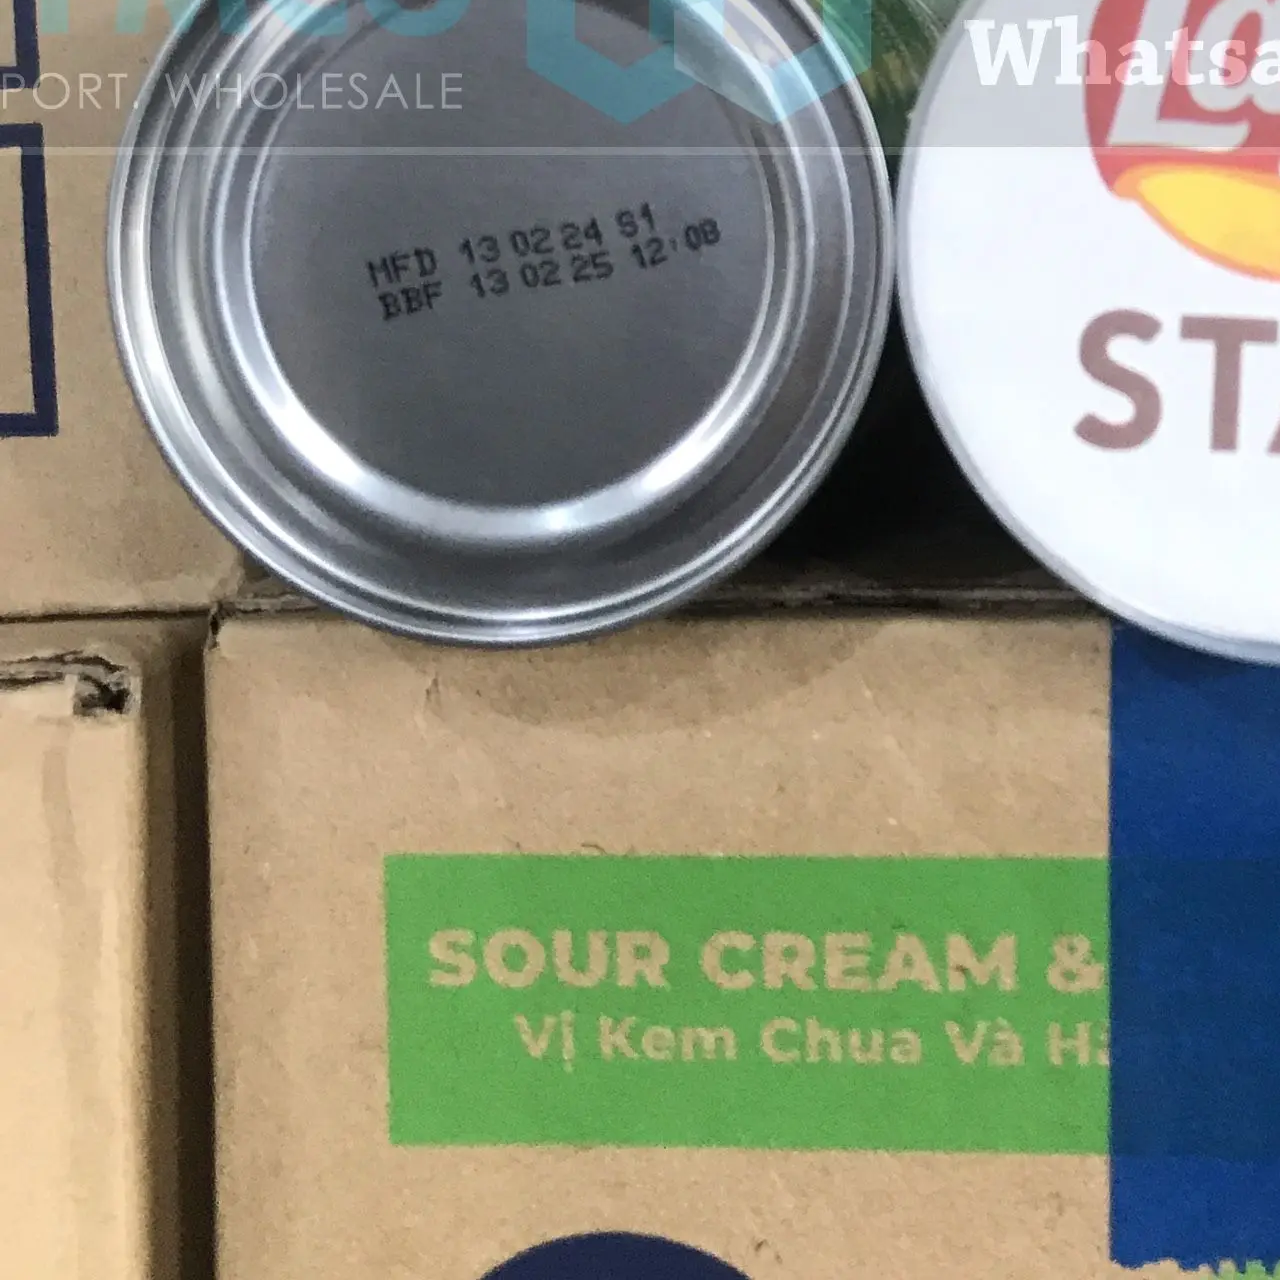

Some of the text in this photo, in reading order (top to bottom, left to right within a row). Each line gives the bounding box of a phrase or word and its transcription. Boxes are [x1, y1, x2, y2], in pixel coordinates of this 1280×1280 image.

[365, 247, 439, 288] MFD
[459, 235, 501, 265] 13
[508, 225, 555, 259] 02
[560, 219, 604, 252] 24
[378, 281, 443, 321] BBF
[470, 268, 511, 298] 13
[519, 258, 562, 288] 02
[570, 251, 615, 285] 25
[428, 928, 1106, 994] SOUR CREAM &
[514, 1008, 576, 1073] Vị
[598, 1016, 738, 1063] Kem
[760, 1016, 923, 1066] Chua
[944, 1017, 1025, 1068] Và
